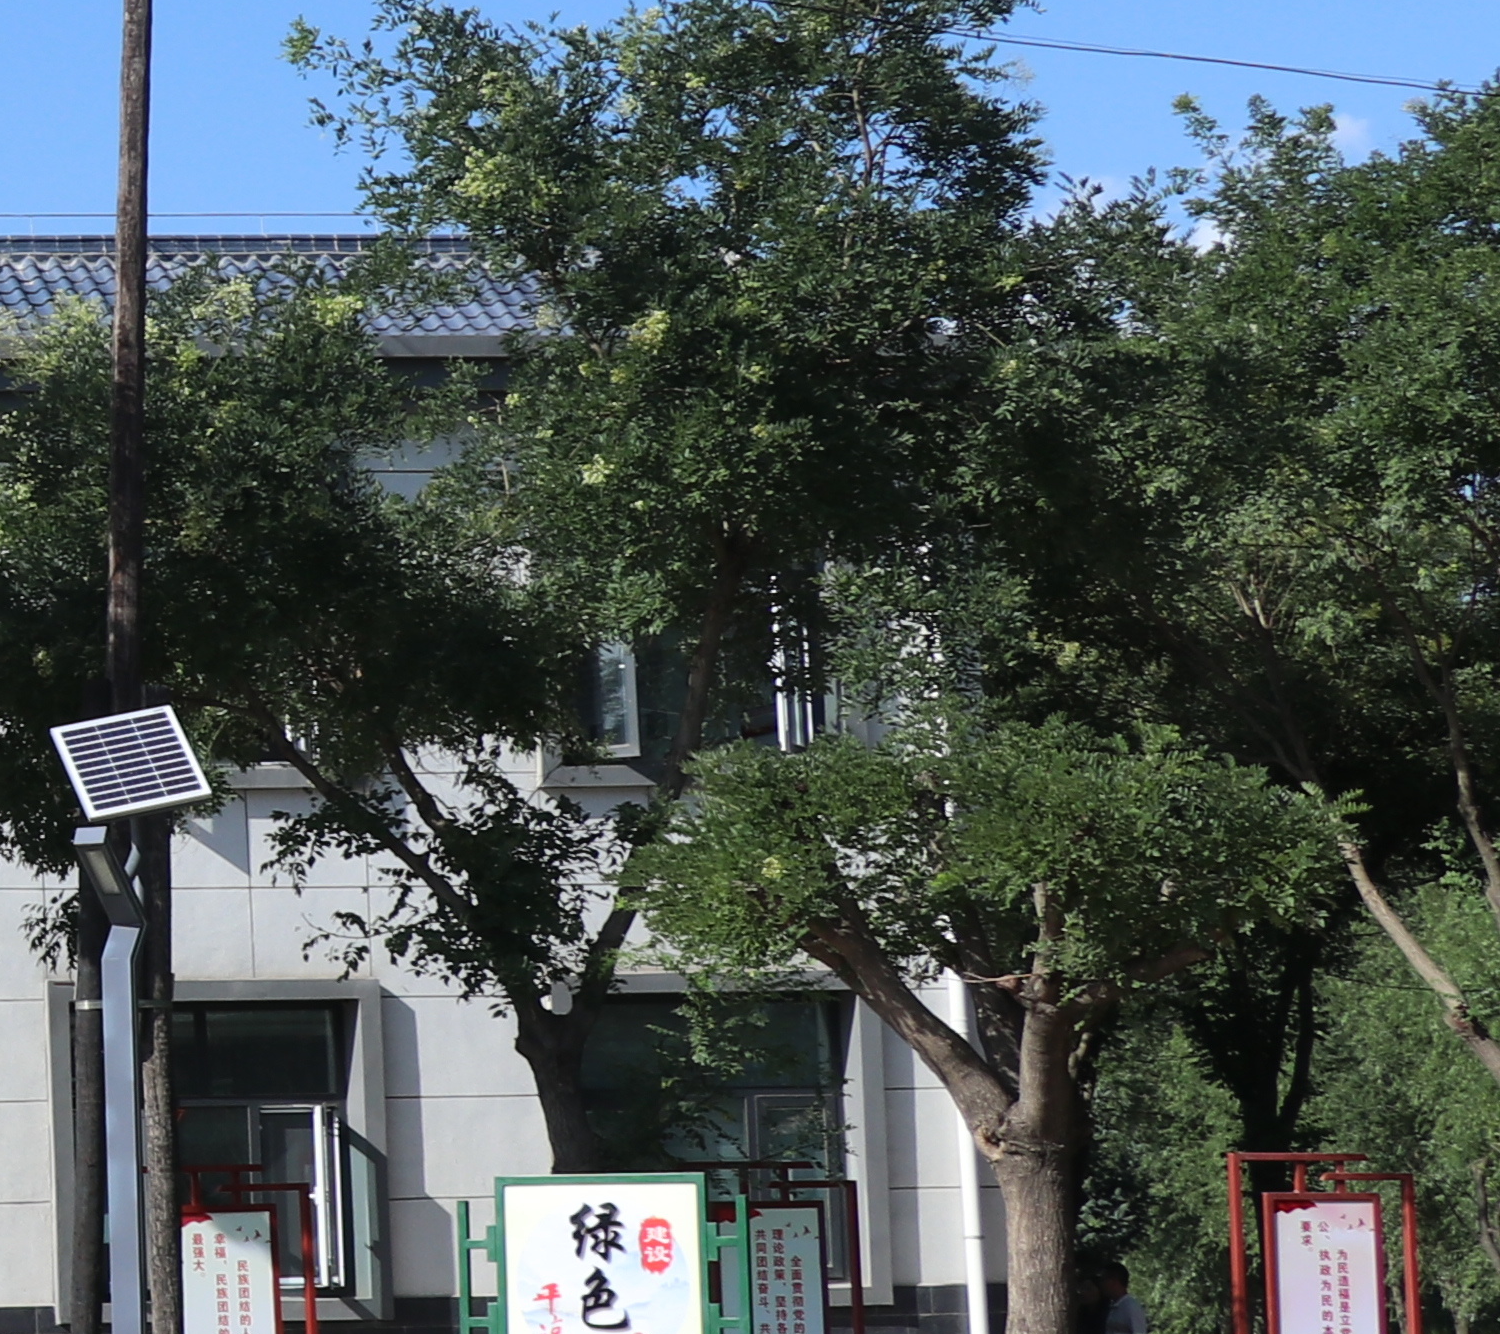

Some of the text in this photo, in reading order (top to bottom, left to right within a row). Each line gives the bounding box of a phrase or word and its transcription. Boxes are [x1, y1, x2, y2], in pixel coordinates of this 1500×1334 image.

[192, 1233, 206, 1278] 最强大。
[643, 1225, 671, 1263] 建设
[1301, 1220, 1314, 1252] 要求。
[569, 1202, 630, 1331] 绿色
